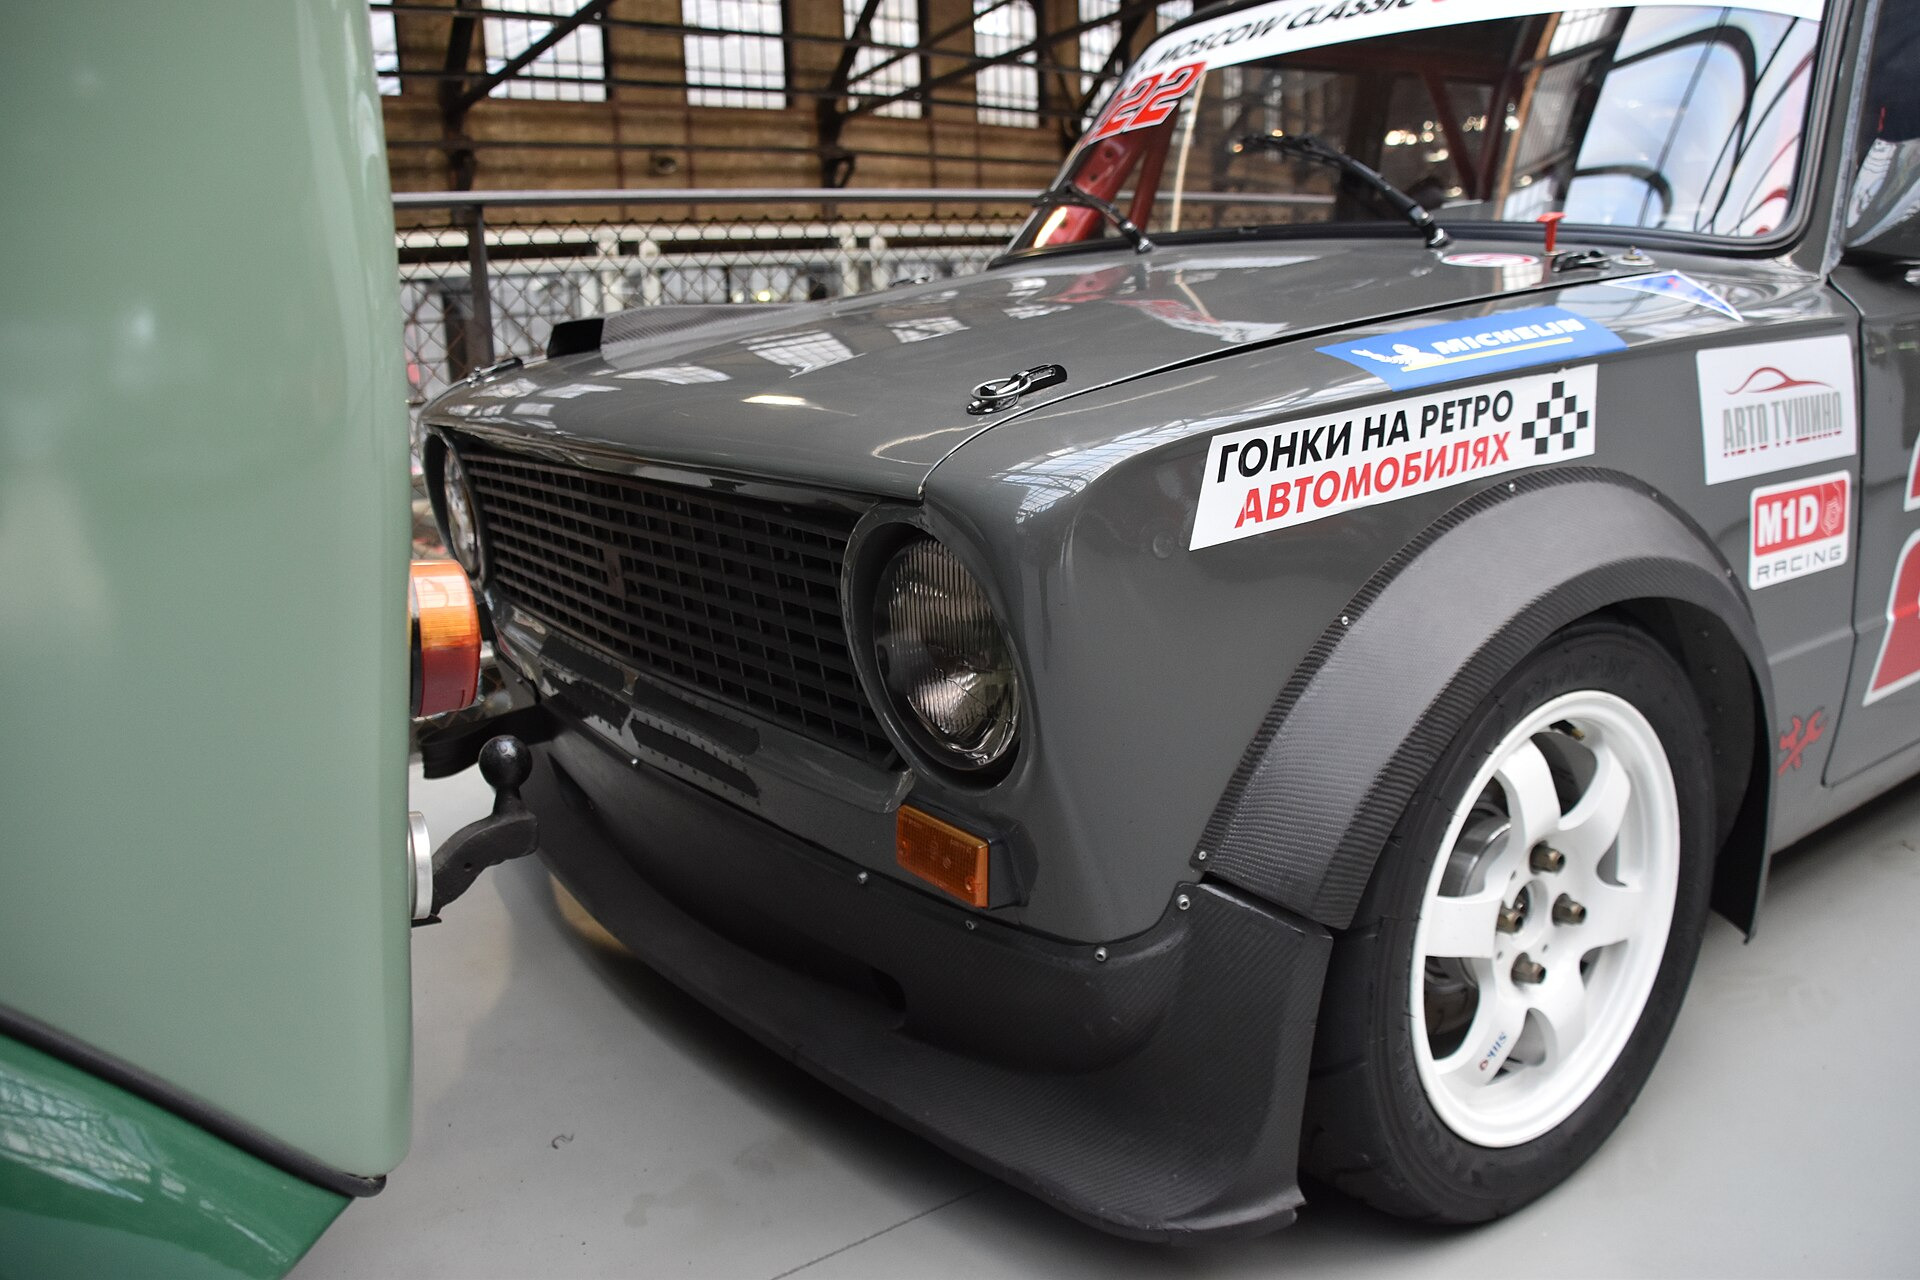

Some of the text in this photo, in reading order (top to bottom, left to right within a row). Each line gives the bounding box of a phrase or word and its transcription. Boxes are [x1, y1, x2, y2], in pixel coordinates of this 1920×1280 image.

[1152, 12, 1289, 67] MOSCOW
[1431, 317, 1586, 355] MICHELIN
[1216, 389, 1514, 483] ГОНКИ НА РЕТРО
[1722, 391, 1843, 458] АВТО ТУШИНО
[1234, 431, 1512, 529] АВТОМОБИЛЯХ
[1757, 494, 1820, 548] M1D
[1756, 544, 1843, 583] RACING
